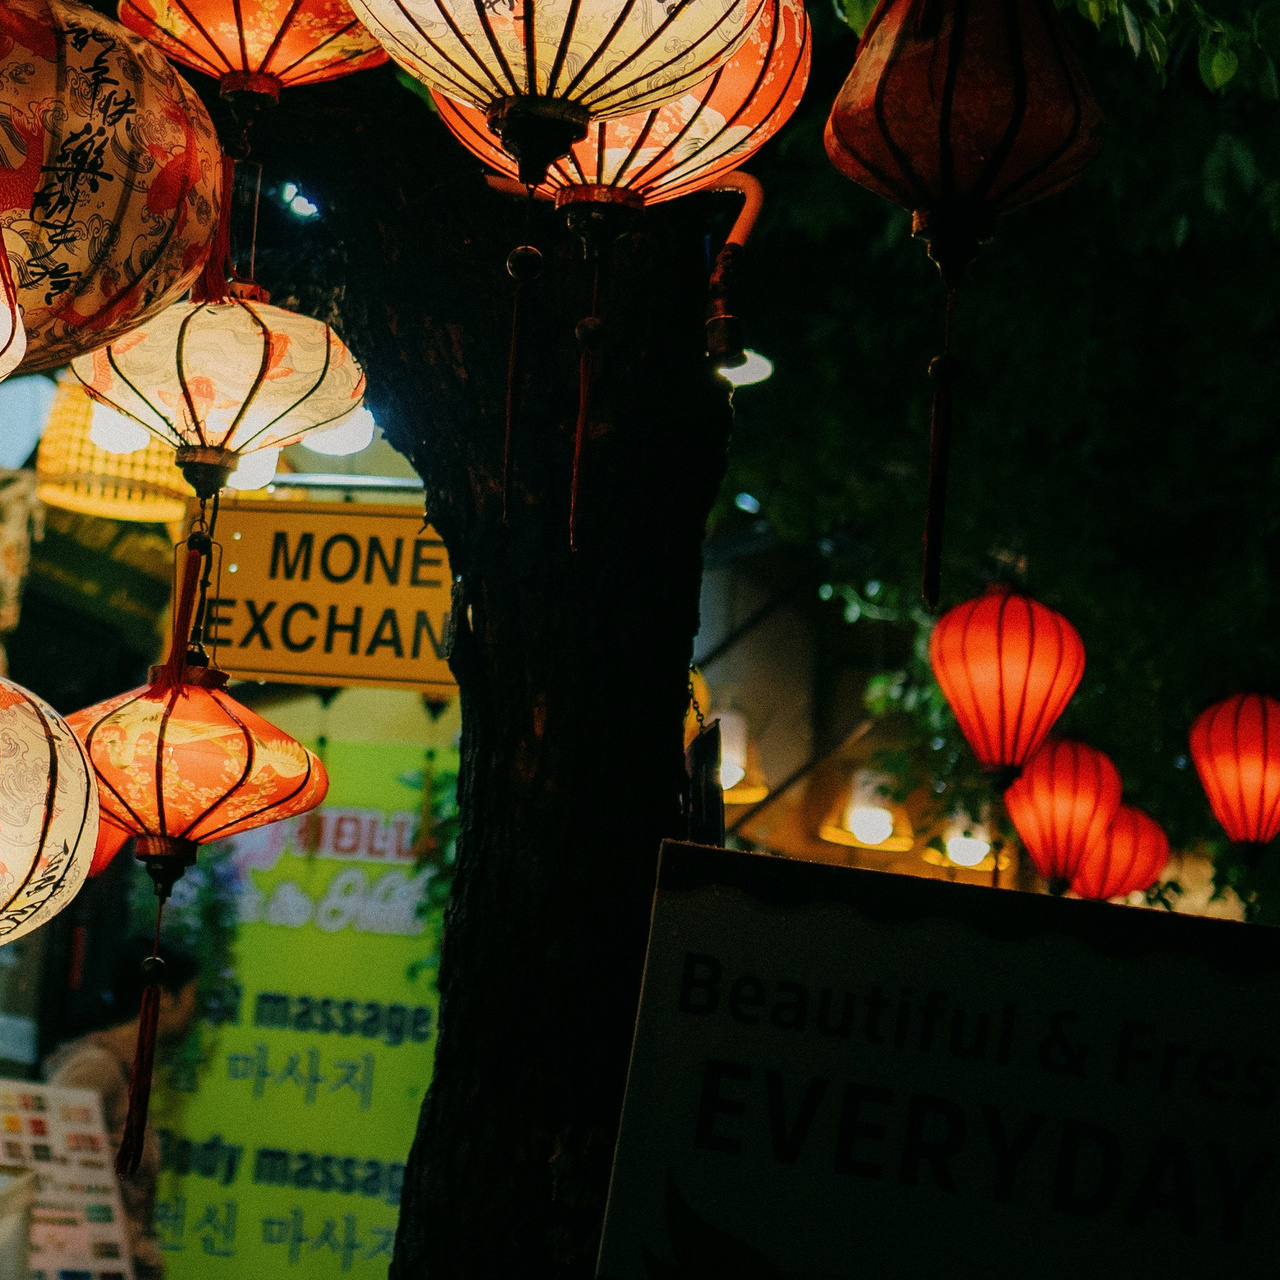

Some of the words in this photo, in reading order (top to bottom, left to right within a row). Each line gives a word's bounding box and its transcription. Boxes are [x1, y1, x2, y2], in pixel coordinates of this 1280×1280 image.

[269, 531, 445, 587] MONE
[202, 597, 451, 660] EXCHAN
[254, 991, 432, 1047] massage
[678, 952, 1017, 1065] Beautiful
[1038, 1011, 1088, 1080] &
[226, 1041, 375, 1111] 마사지
[694, 1058, 1276, 1243] EVERYDAY
